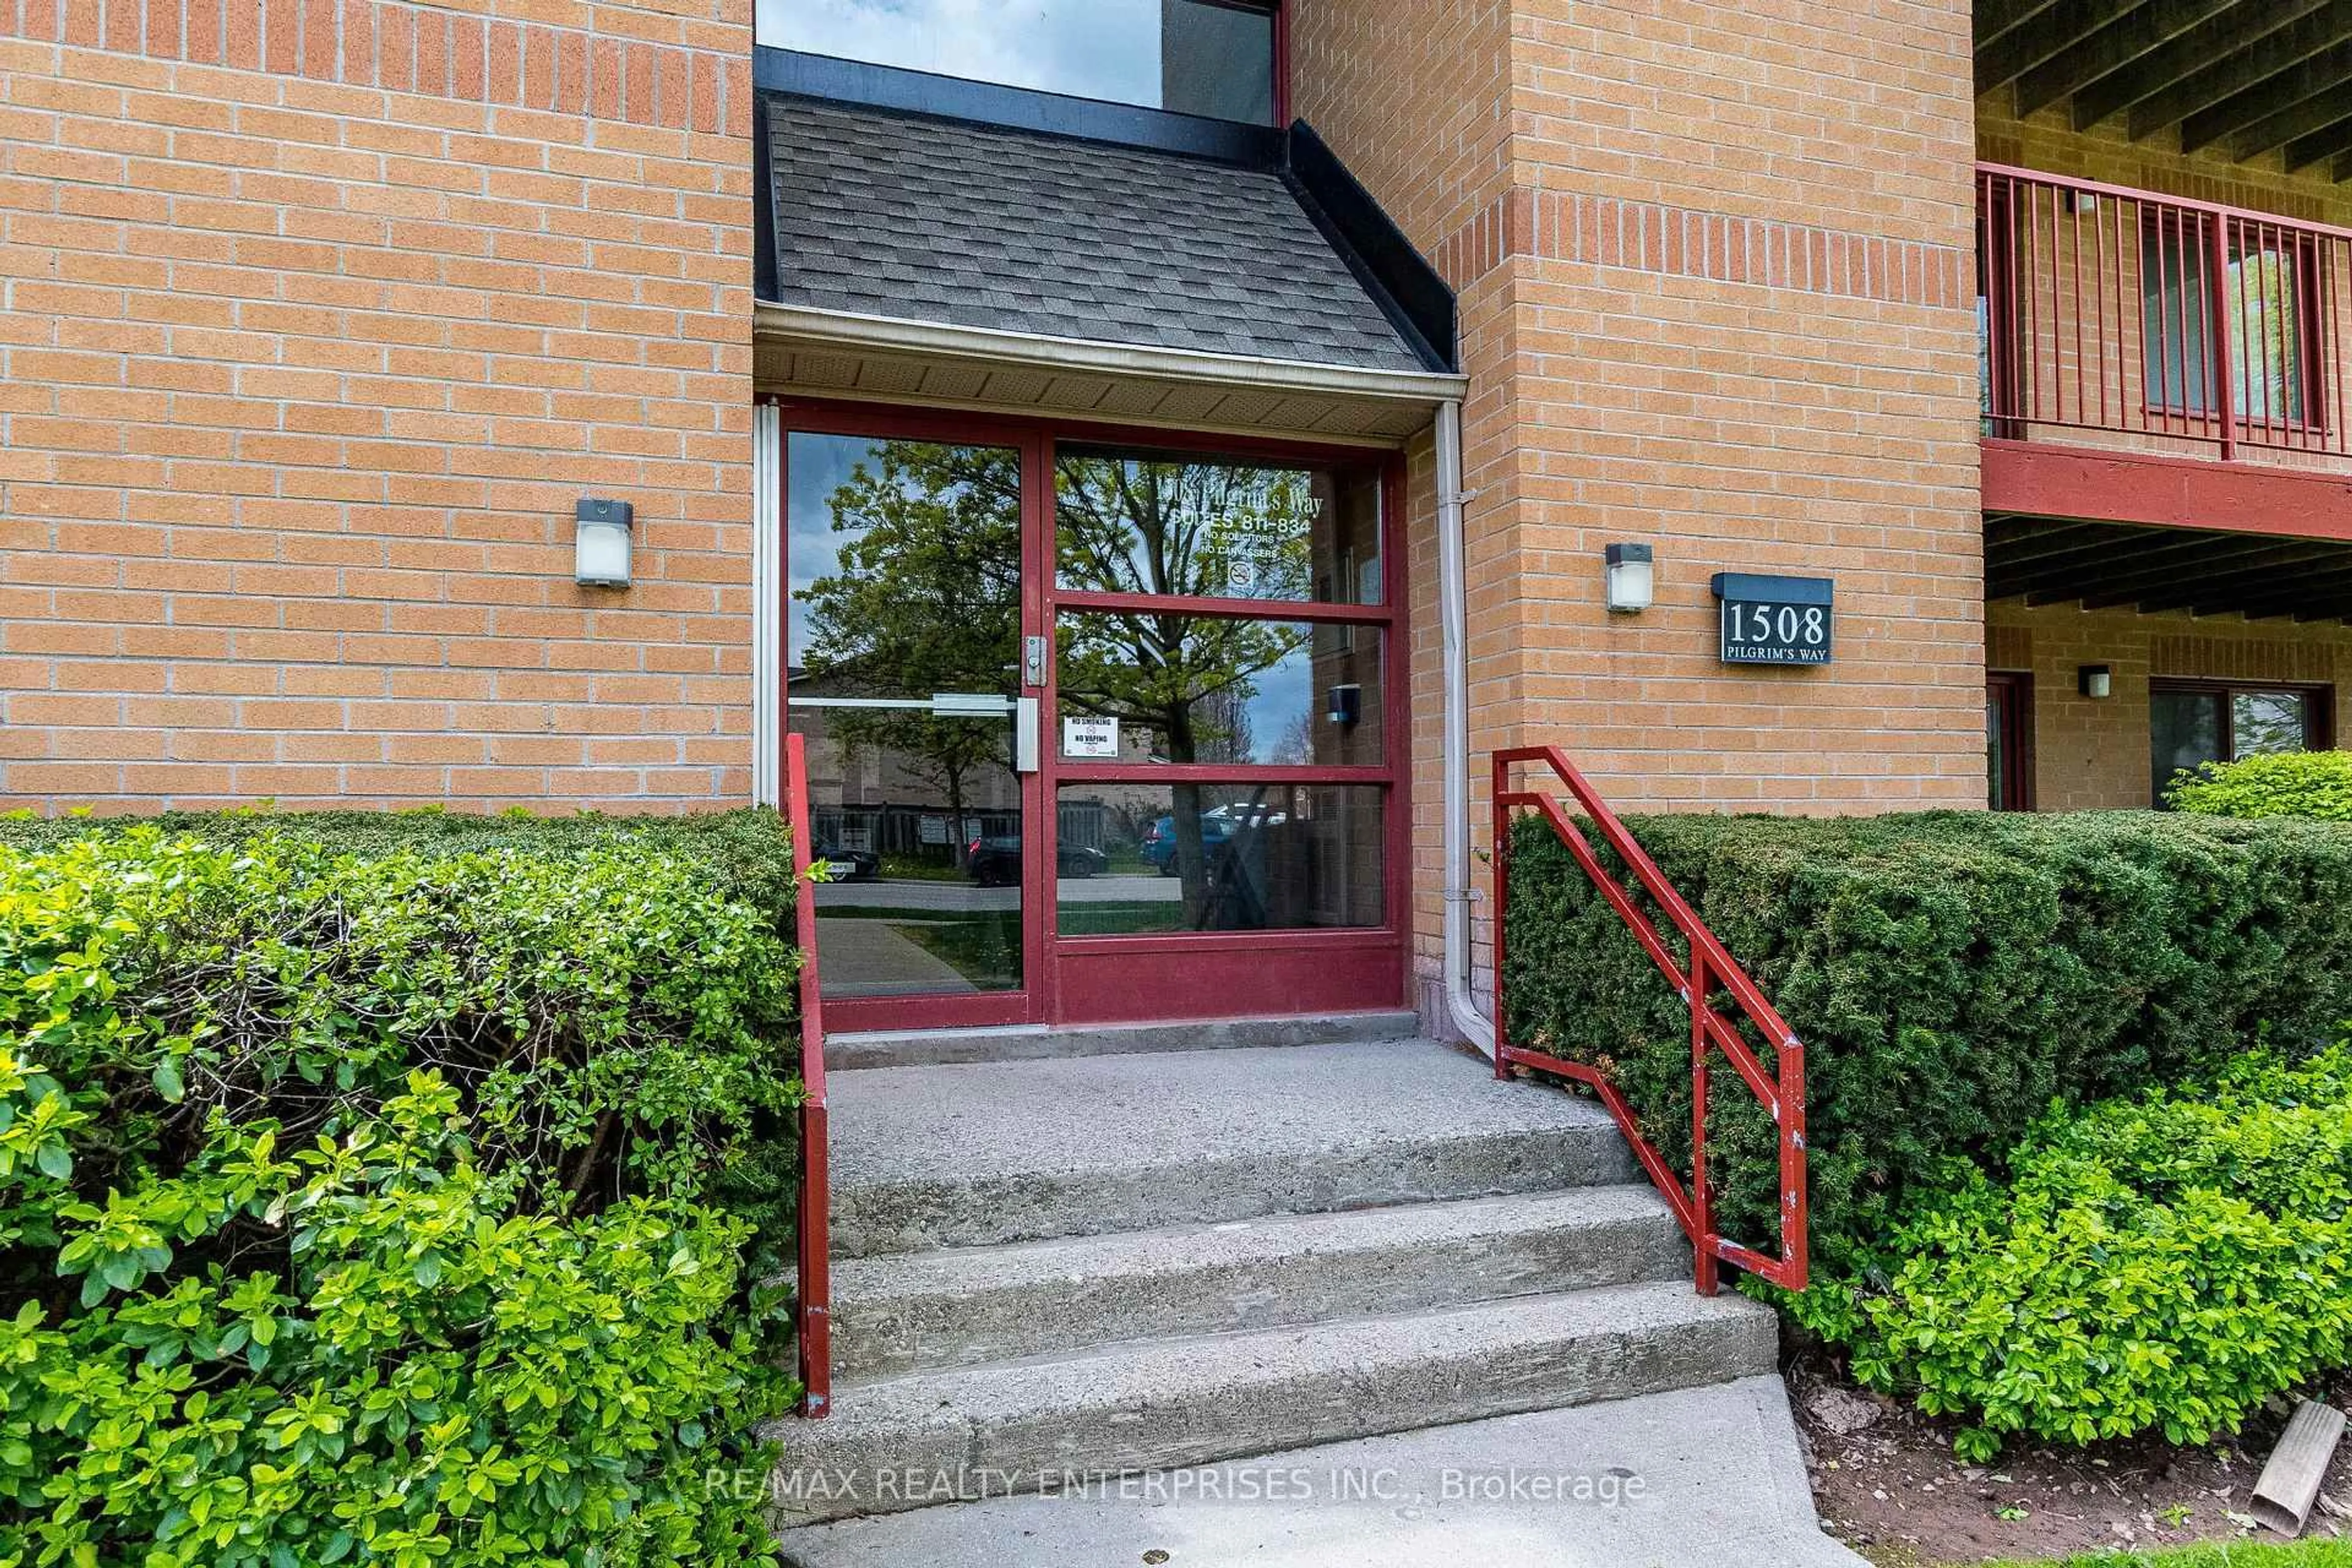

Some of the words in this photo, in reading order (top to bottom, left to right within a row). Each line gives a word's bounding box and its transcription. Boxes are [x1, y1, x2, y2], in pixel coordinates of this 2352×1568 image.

[1289, 488, 1324, 518] Way
[1169, 508, 1233, 529] SUITES
[1243, 514, 1311, 534] 811-834
[1204, 530, 1218, 539] NO
[1221, 531, 1275, 544] SOLICITORS
[1201, 545, 1215, 553] NO
[1218, 546, 1278, 558] CANVASSERS
[1731, 604, 1823, 644] 1508
[1727, 646, 1795, 660] PILGRIM'S
[1800, 649, 1826, 660] WAY
